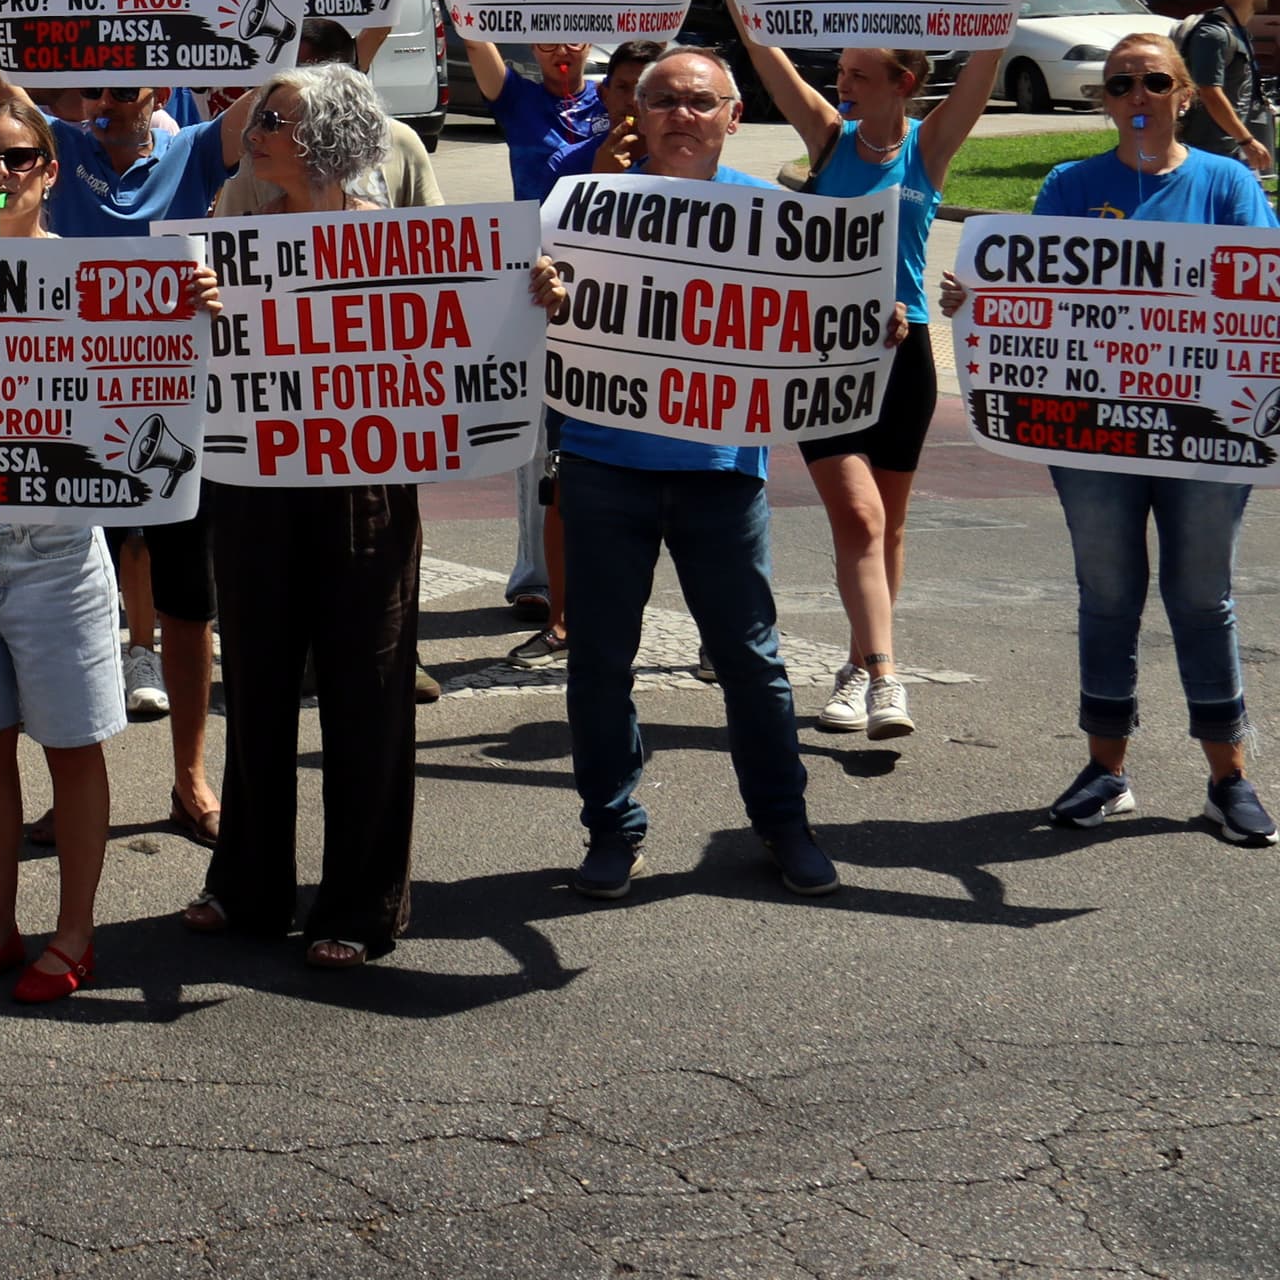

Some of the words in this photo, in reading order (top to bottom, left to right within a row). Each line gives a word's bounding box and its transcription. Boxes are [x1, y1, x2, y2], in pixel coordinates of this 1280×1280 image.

[479, 10, 526, 34] SOLER,
[531, 13, 561, 31] MENYS
[563, 13, 615, 34] DISCURSOS,
[617, 9, 636, 32] MÉS
[557, 181, 737, 253] Navarro
[748, 198, 764, 256] i
[776, 200, 884, 263] Soler
[974, 235, 1164, 287] CRESPIN
[1174, 256, 1179, 286] i
[1187, 259, 1205, 288] el
[39, 279, 44, 310] i
[51, 278, 70, 310] el
[80, 266, 194, 315] "PRO"
[262, 290, 471, 356] LLEIDA
[5, 335, 74, 362] VOLEM
[82, 335, 199, 363] SOLUCIONS.
[38, 377, 43, 401] I
[52, 377, 89, 402] FEU
[97, 376, 126, 402] LA
[132, 375, 195, 402] FEINA!
[256, 414, 461, 477] PROu!
